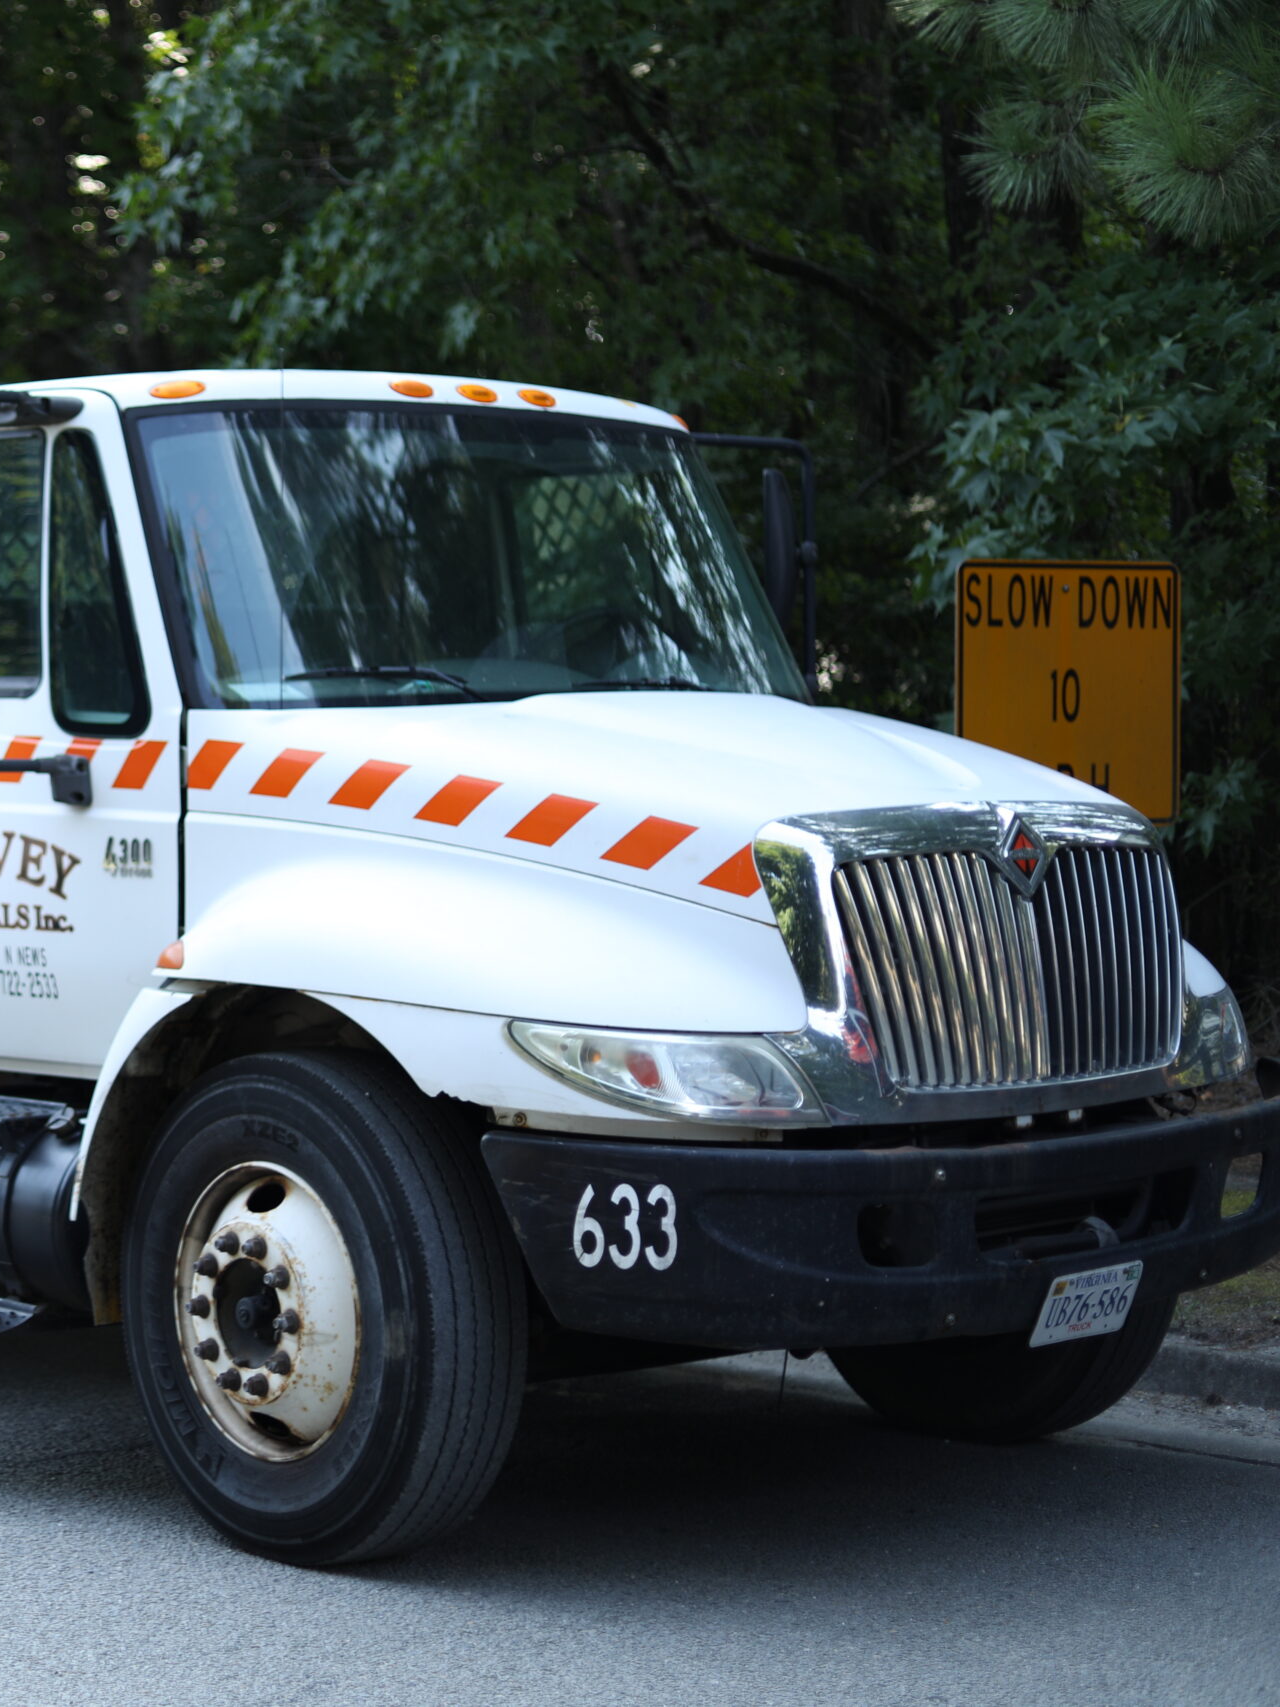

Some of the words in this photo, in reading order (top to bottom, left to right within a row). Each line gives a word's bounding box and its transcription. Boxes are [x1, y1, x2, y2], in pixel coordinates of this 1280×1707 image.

[965, 572, 1054, 628] SLOW
[1078, 575, 1172, 630] DOWN
[1050, 668, 1081, 723] 10
[34, 904, 75, 933] Inc.
[18, 945, 48, 967] NEWS
[241, 1118, 300, 1153] XZE2
[573, 1182, 678, 1271] 633
[1075, 1271, 1118, 1289] VIRGINIA
[1045, 1283, 1133, 1328] UB76-586
